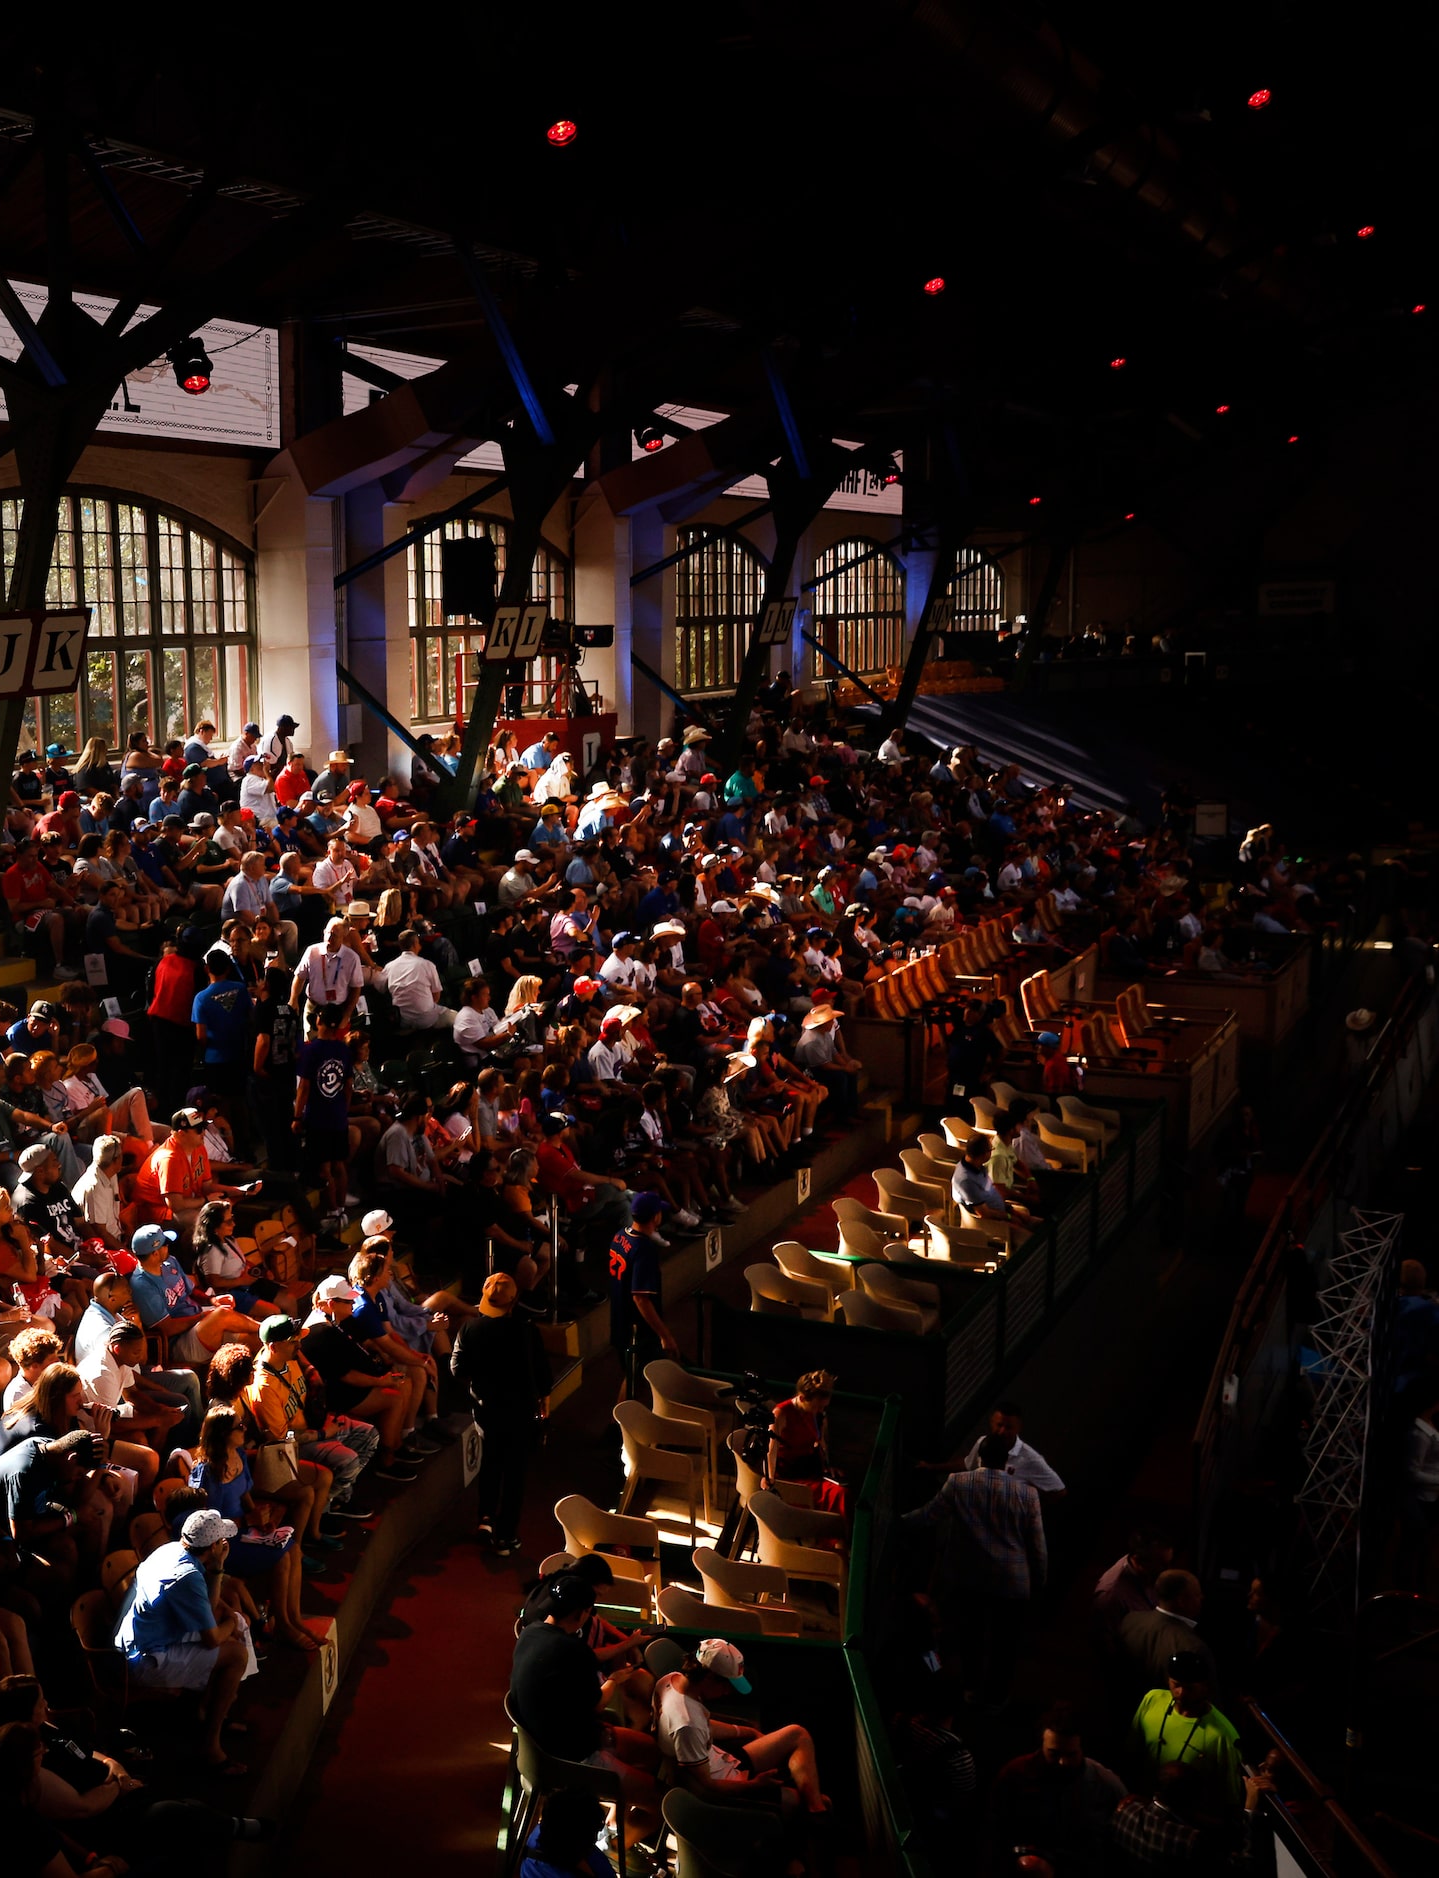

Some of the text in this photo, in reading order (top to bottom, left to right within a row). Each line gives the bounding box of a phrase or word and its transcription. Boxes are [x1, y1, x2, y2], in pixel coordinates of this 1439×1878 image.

[491, 616, 538, 648] K L
[763, 609, 793, 633] L M
[39, 630, 80, 673] K
[609, 1248, 628, 1281] 27
